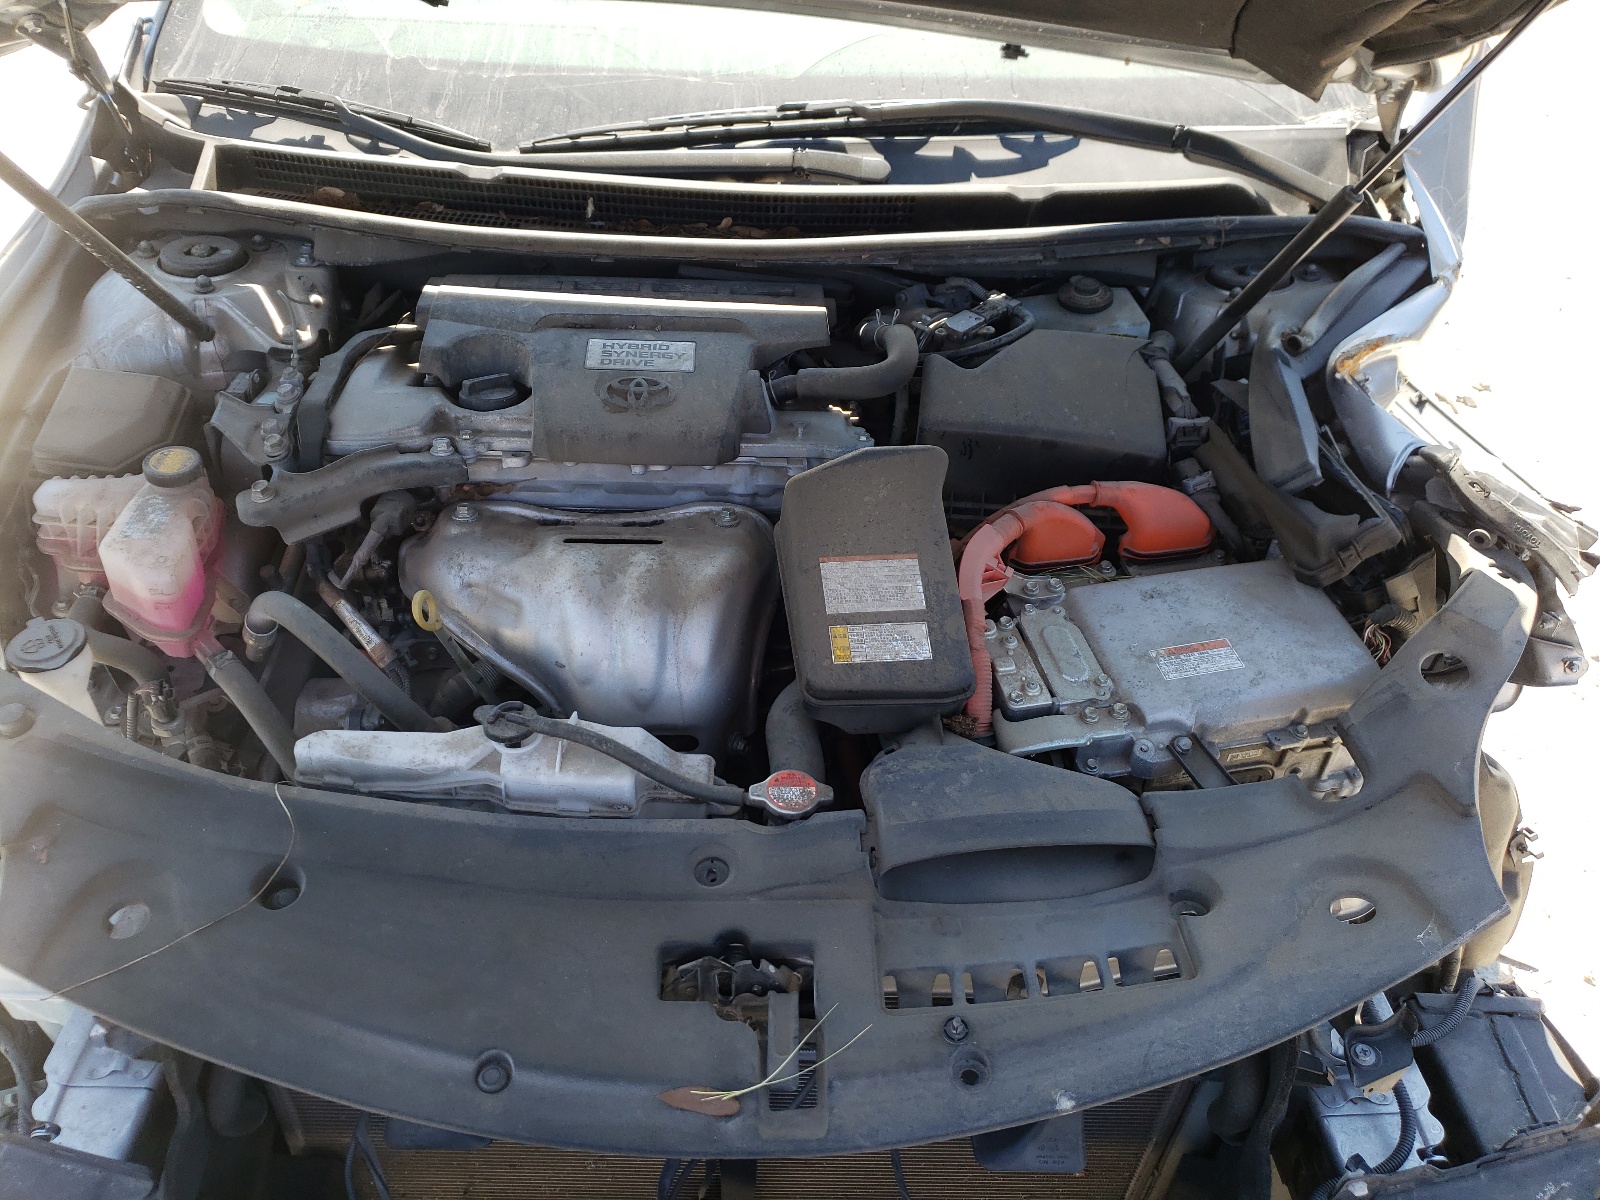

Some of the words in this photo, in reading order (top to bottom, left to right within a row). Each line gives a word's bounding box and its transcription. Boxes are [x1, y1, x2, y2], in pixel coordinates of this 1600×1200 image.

[603, 342, 669, 351] HYBRID
[601, 350, 686, 360] SYNERGY
[600, 358, 654, 367] DRIVE
